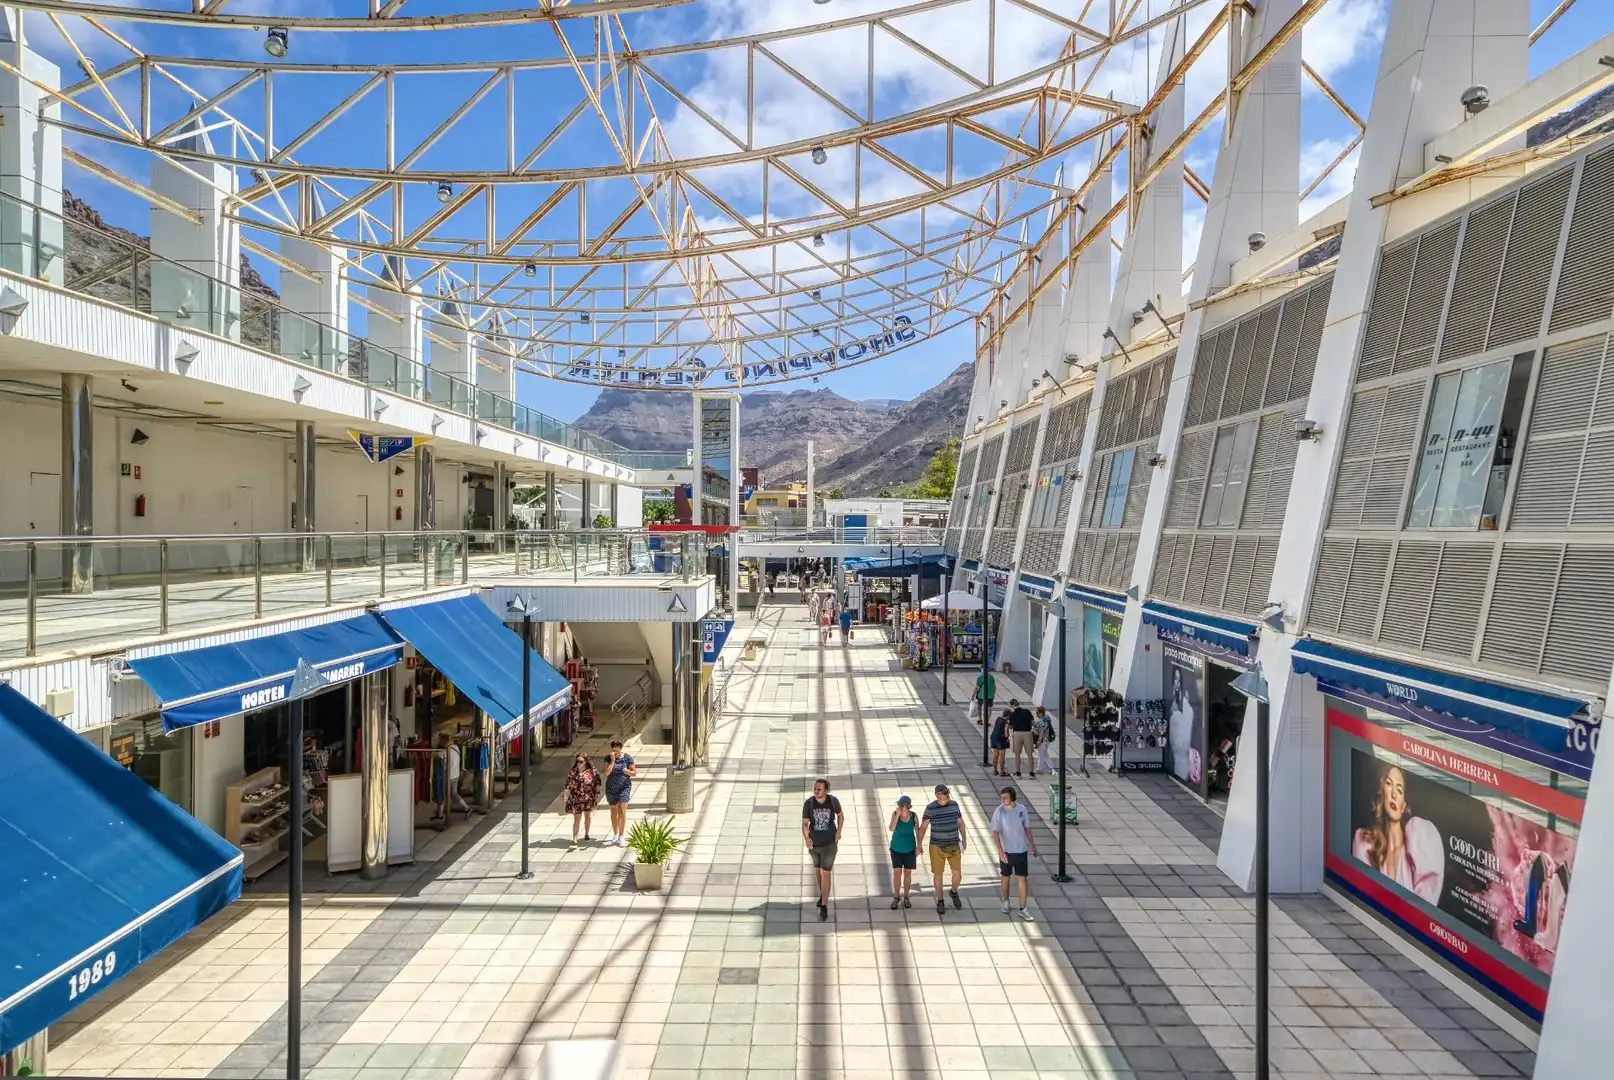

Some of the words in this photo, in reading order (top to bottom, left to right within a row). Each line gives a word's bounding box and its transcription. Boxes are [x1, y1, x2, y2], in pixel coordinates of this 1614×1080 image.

[1450, 442, 1491, 452] RESTAURANT
[1164, 646, 1178, 657] paco
[1178, 650, 1203, 667] rabanne
[241, 684, 285, 710] HORTEN
[1386, 682, 1418, 701] WORLD
[1402, 740, 1449, 767] CAROLINA
[1449, 755, 1500, 786] HERRERA
[1449, 835, 1476, 859] GOOD
[1476, 849, 1504, 874] GIRL
[1449, 853, 1476, 871] CAROLINA
[1477, 866, 1504, 885] HERRERA
[68, 951, 116, 1001] 1989
